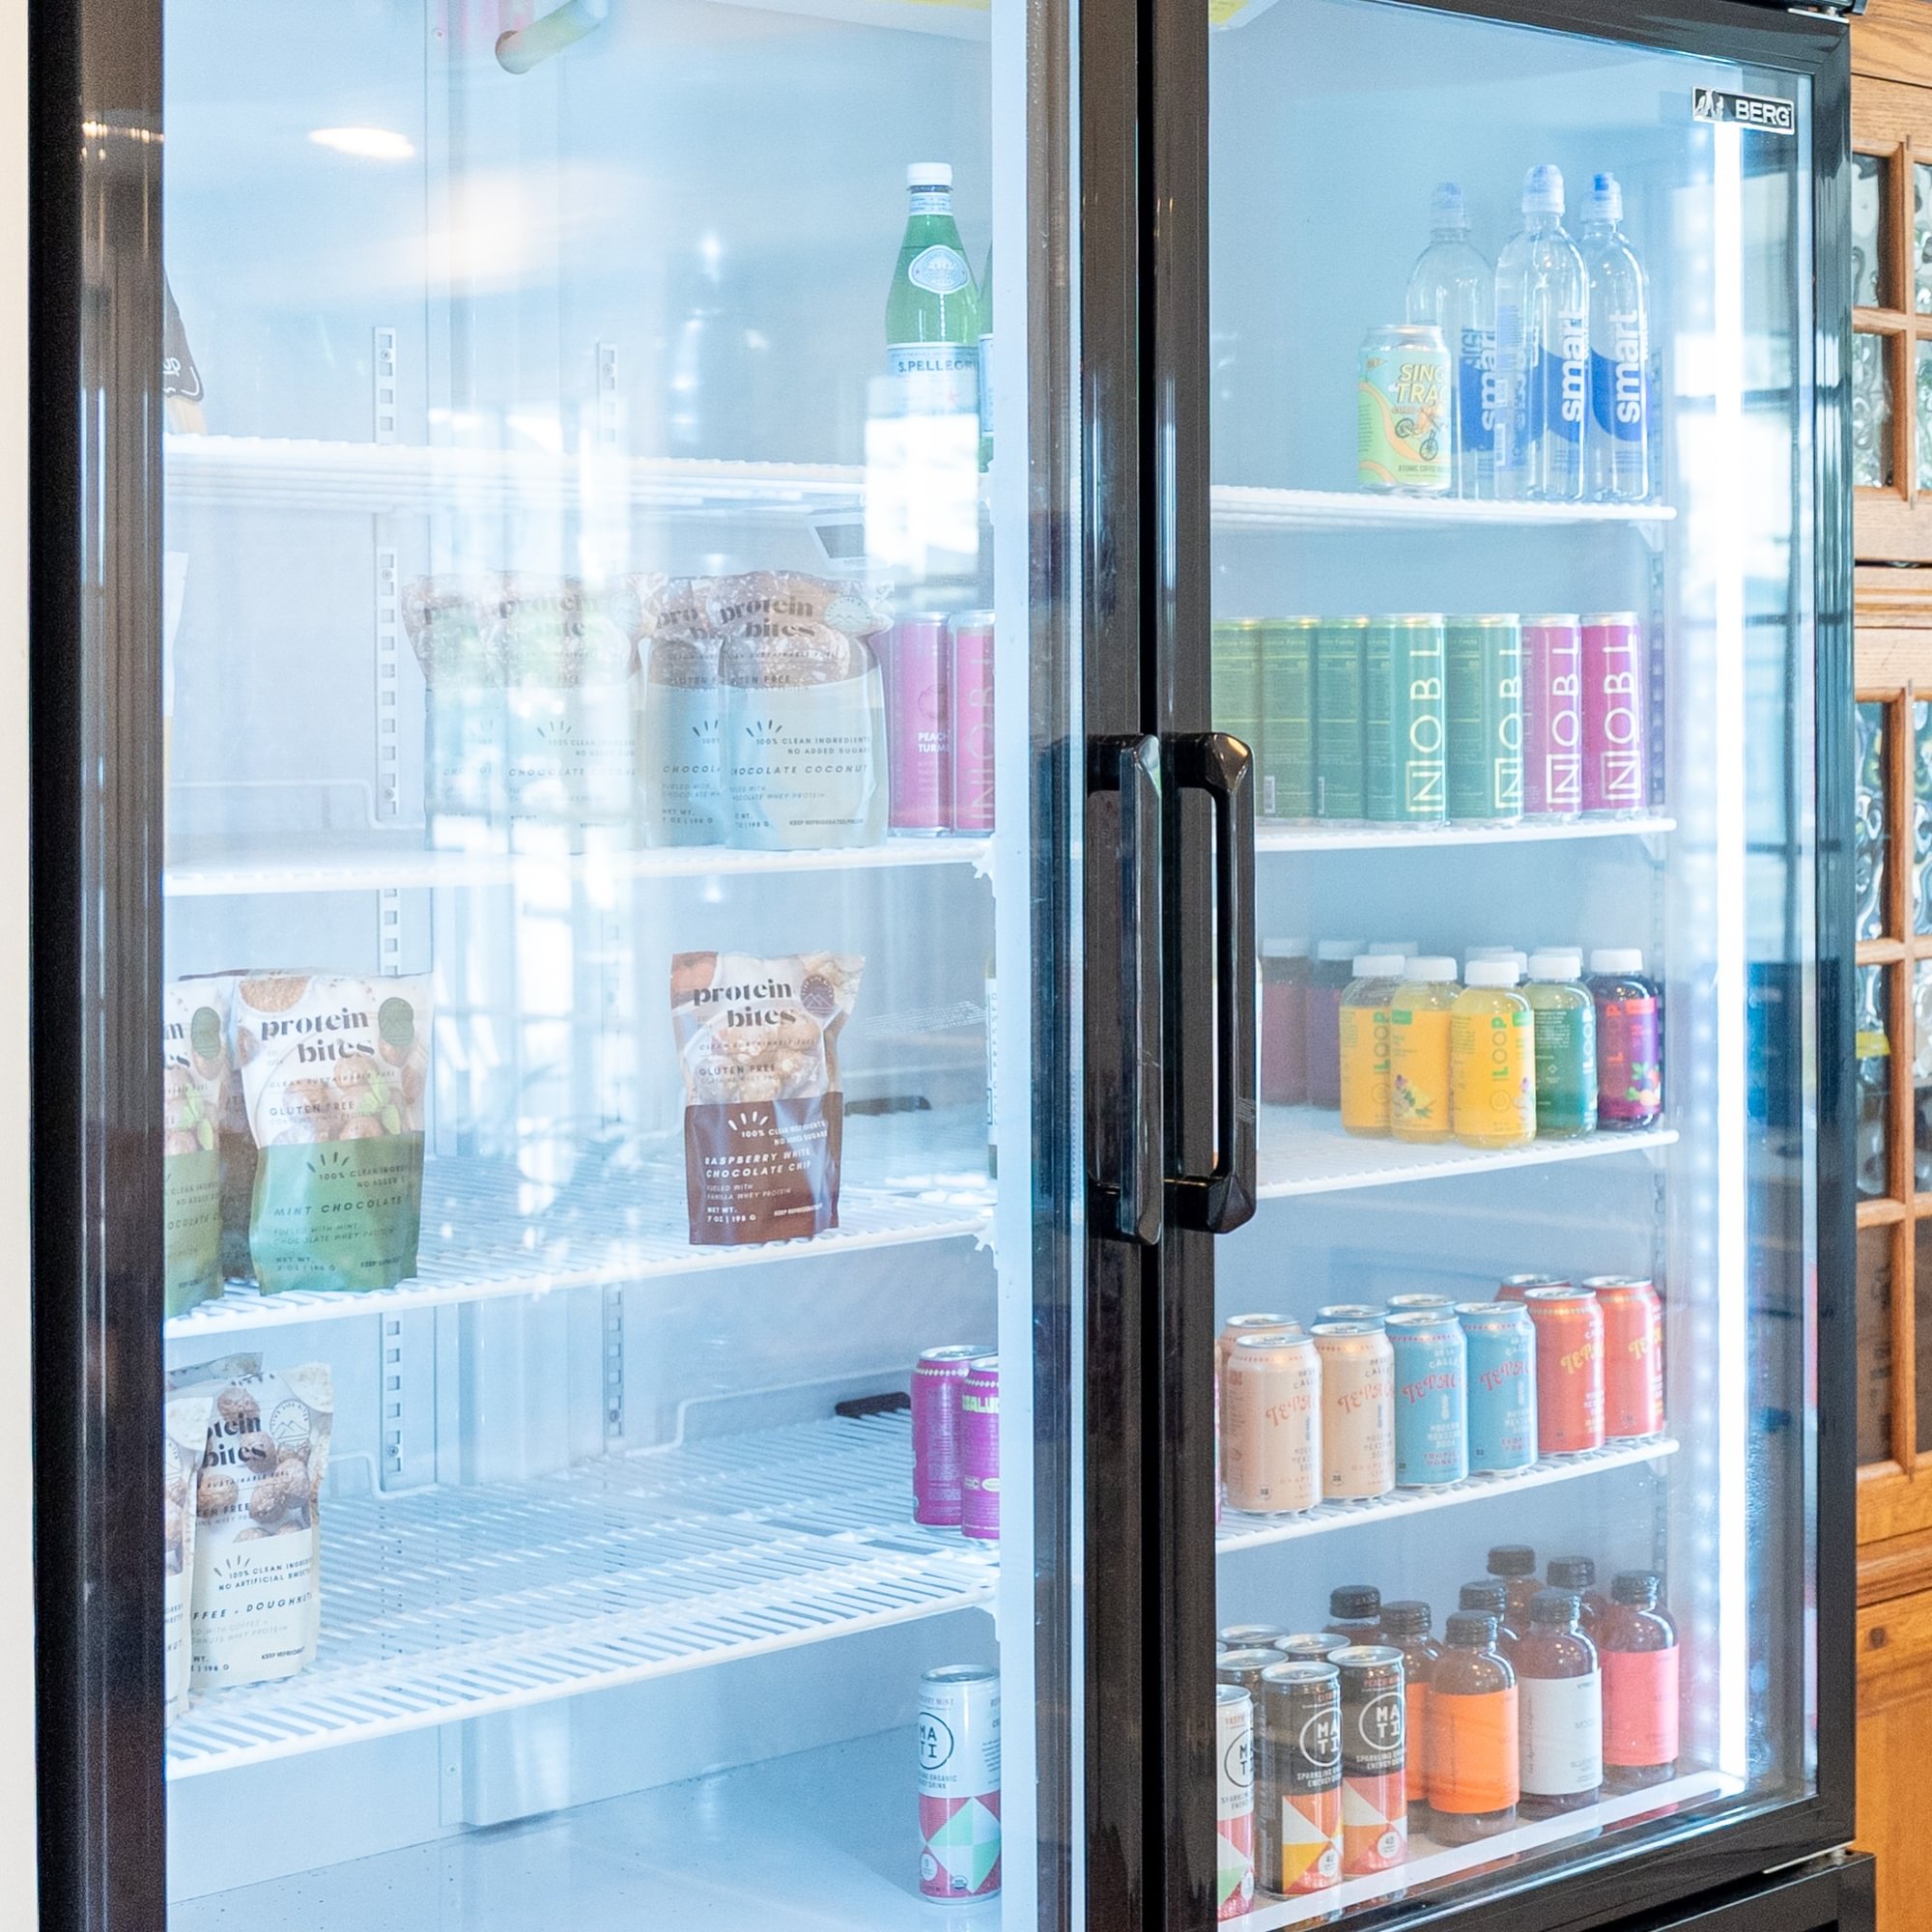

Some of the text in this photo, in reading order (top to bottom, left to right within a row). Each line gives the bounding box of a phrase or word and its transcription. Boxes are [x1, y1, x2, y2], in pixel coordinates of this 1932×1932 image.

[1735, 99, 1791, 127] BERG
[1558, 309, 1584, 423] smart
[1608, 309, 1641, 424] smart
[720, 595, 813, 624] protein
[744, 616, 816, 638] bites
[1408, 638, 1444, 806] NOBL
[1603, 633, 1640, 794] NOBL
[694, 979, 792, 1007] protein
[261, 1008, 369, 1041] protein
[726, 1006, 797, 1028] bites
[298, 1039, 375, 1064] bites
[1492, 1016, 1509, 1078] LOOP
[699, 1065, 744, 1076] GLUTEN
[270, 1104, 321, 1117] GLUTEN
[705, 1152, 778, 1166] RASPBERRY
[705, 1164, 783, 1179] CHOCOLATE
[273, 1196, 402, 1217] MINT CHOCOLATE
[252, 1564, 283, 1575] CLEAN
[235, 1575, 285, 1588] ARTIFICIAL
[1376, 1703, 1401, 1722] MA
[1317, 1721, 1339, 1740] MA
[1377, 1720, 1401, 1739] TI
[1317, 1738, 1340, 1755] TI
